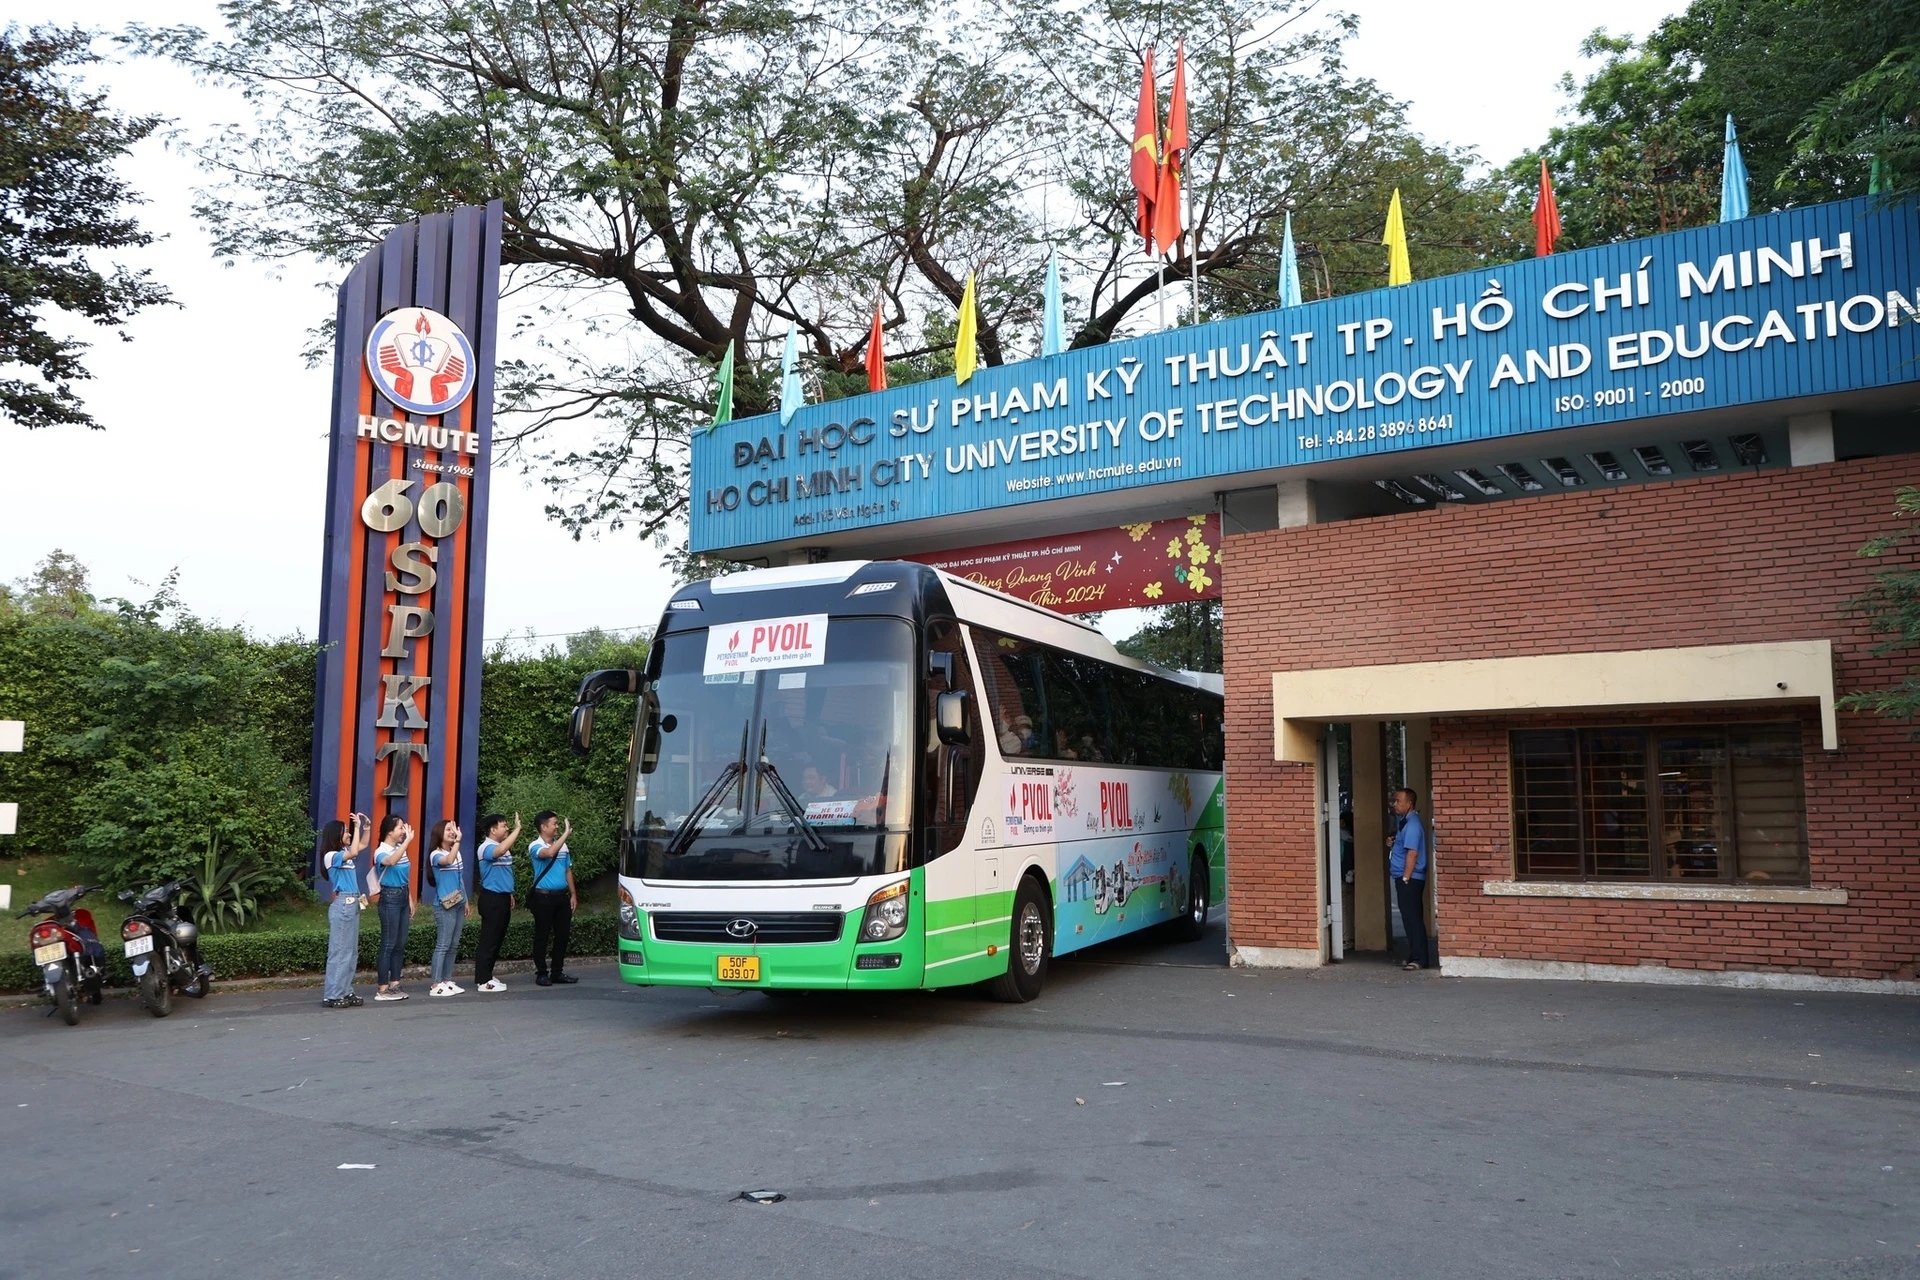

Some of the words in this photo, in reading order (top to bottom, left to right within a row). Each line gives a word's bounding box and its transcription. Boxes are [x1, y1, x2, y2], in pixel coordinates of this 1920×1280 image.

[733, 433, 787, 470] ĐẠI
[799, 417, 876, 458] HỌC
[889, 398, 939, 437] SƯ
[951, 377, 1068, 427] PHẠM
[1087, 356, 1144, 401] KỸ
[1165, 330, 1313, 386] THUẬT
[1432, 278, 1514, 340] HỒ
[1542, 255, 1653, 319] CHÍ
[1677, 231, 1853, 298] MINH
[706, 485, 741, 514] HO
[747, 476, 789, 506] CHI
[796, 464, 862, 500] MINH
[870, 451, 936, 487] CITY
[945, 417, 1127, 474] UNIVERSITY
[1139, 407, 1183, 442] OF
[1196, 359, 1473, 433] TECHNOLOGY
[1489, 343, 1592, 389] AND
[1608, 287, 1920, 371] EDUCATION
[1555, 394, 1591, 413] ISO:
[1594, 387, 1635, 407] 9001
[1660, 377, 1705, 398] 2000
[357, 414, 480, 455] HCMUTE
[1327, 425, 1376, 446] +84.28
[1379, 419, 1415, 438] 3896
[1418, 414, 1453, 432] 8641
[412, 458, 445, 473] Since
[447, 464, 474, 477] 1962
[1006, 475, 1054, 493] Website:
[1056, 455, 1182, 485] www.hcmute.edu.vn
[361, 478, 464, 538] 60
[960, 559, 974, 567] HỌC
[984, 555, 1001, 564] PHẠM
[1002, 553, 1011, 561] KỸ
[1012, 550, 1030, 560] THUẬT
[1051, 546, 1063, 554] CHÍ
[1006, 566, 1052, 589] Quang
[1056, 560, 1097, 581] Vinh
[1065, 583, 1107, 603] 2024
[751, 622, 813, 655] PVOIL
[375, 542, 439, 797] SPKT
[1011, 766, 1045, 775] UNIVERSE
[1022, 783, 1052, 820] PVOIL
[1100, 782, 1133, 830] PVOIL
[722, 968, 755, 979] 039.07
[729, 957, 748, 968] 50F
